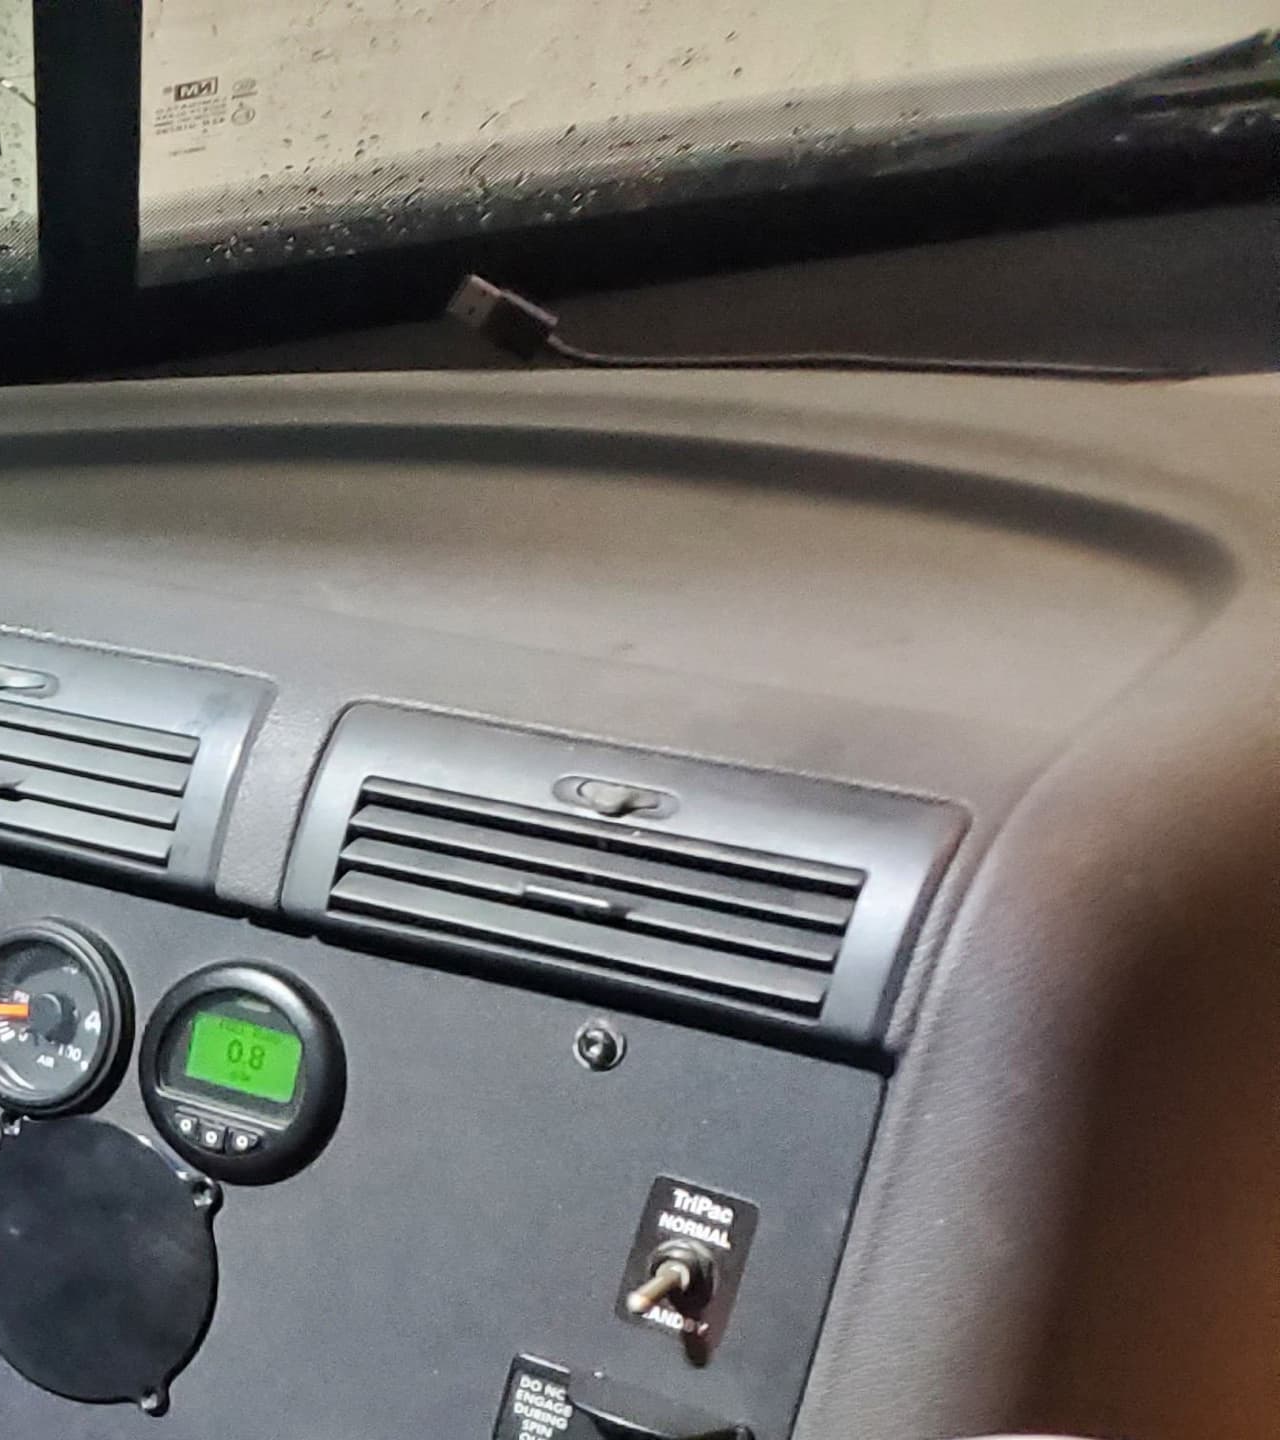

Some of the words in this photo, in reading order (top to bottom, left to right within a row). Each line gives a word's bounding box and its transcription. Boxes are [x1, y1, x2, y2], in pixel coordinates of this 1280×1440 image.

[673, 1188, 734, 1224] TriPac
[659, 1213, 731, 1249] NORMAL
[642, 1306, 709, 1335] ANDBY
[520, 1375, 542, 1392] DO
[545, 1384, 567, 1401] NO
[513, 1402, 568, 1430] DURING
[516, 1389, 573, 1418] ENGAGE
[521, 1419, 553, 1438] SPIN
